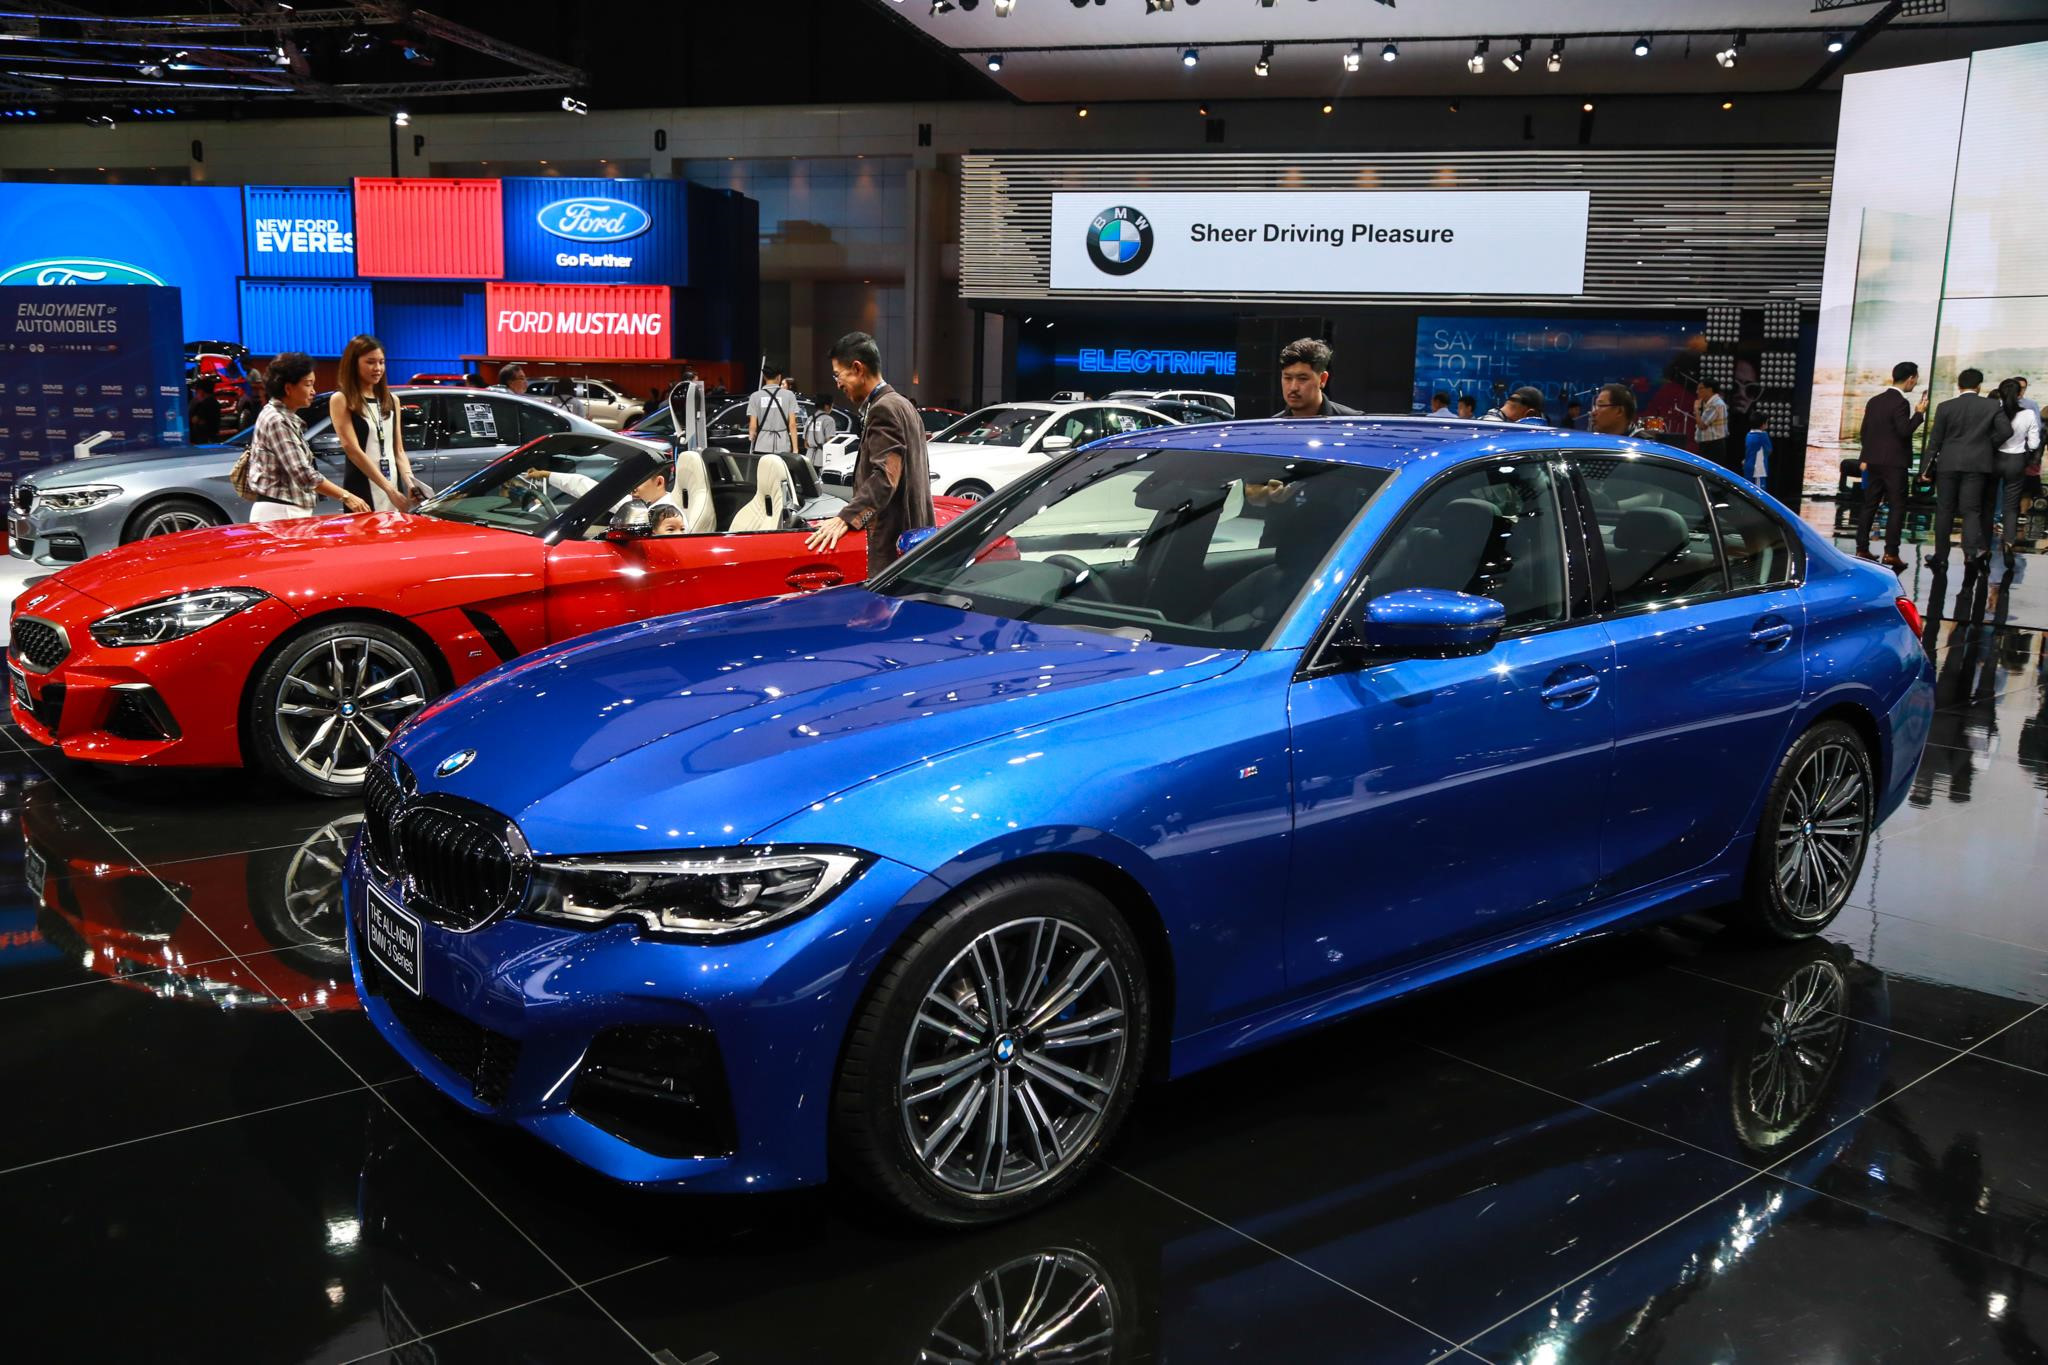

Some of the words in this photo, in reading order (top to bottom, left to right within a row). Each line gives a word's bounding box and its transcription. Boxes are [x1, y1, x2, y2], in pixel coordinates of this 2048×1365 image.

[414, 135, 424, 157] P
[256, 218, 292, 232] NEW
[295, 219, 339, 233] FORD
[558, 203, 626, 232] Ford
[1093, 207, 1149, 231] BMW
[1190, 223, 1257, 242] Sheer
[1263, 223, 1344, 247] Driving
[1351, 223, 1454, 243] Pleasure
[556, 253, 578, 267] Go
[579, 253, 632, 267] Further
[17, 303, 106, 317] ENJOYMENT
[106, 306, 118, 314] OF
[16, 320, 117, 333] AUTOMOBILES
[498, 310, 553, 333] FORD
[556, 312, 661, 335] MUSTANG
[1433, 329, 1477, 351] SAY
[1433, 354, 1466, 374] TO
[1471, 355, 1521, 376] THE
[370, 902, 382, 928] THE
[383, 915, 414, 953] ALL-NEW
[371, 924, 386, 951] BMW
[387, 940, 392, 957] 3
[393, 944, 414, 975] Series
